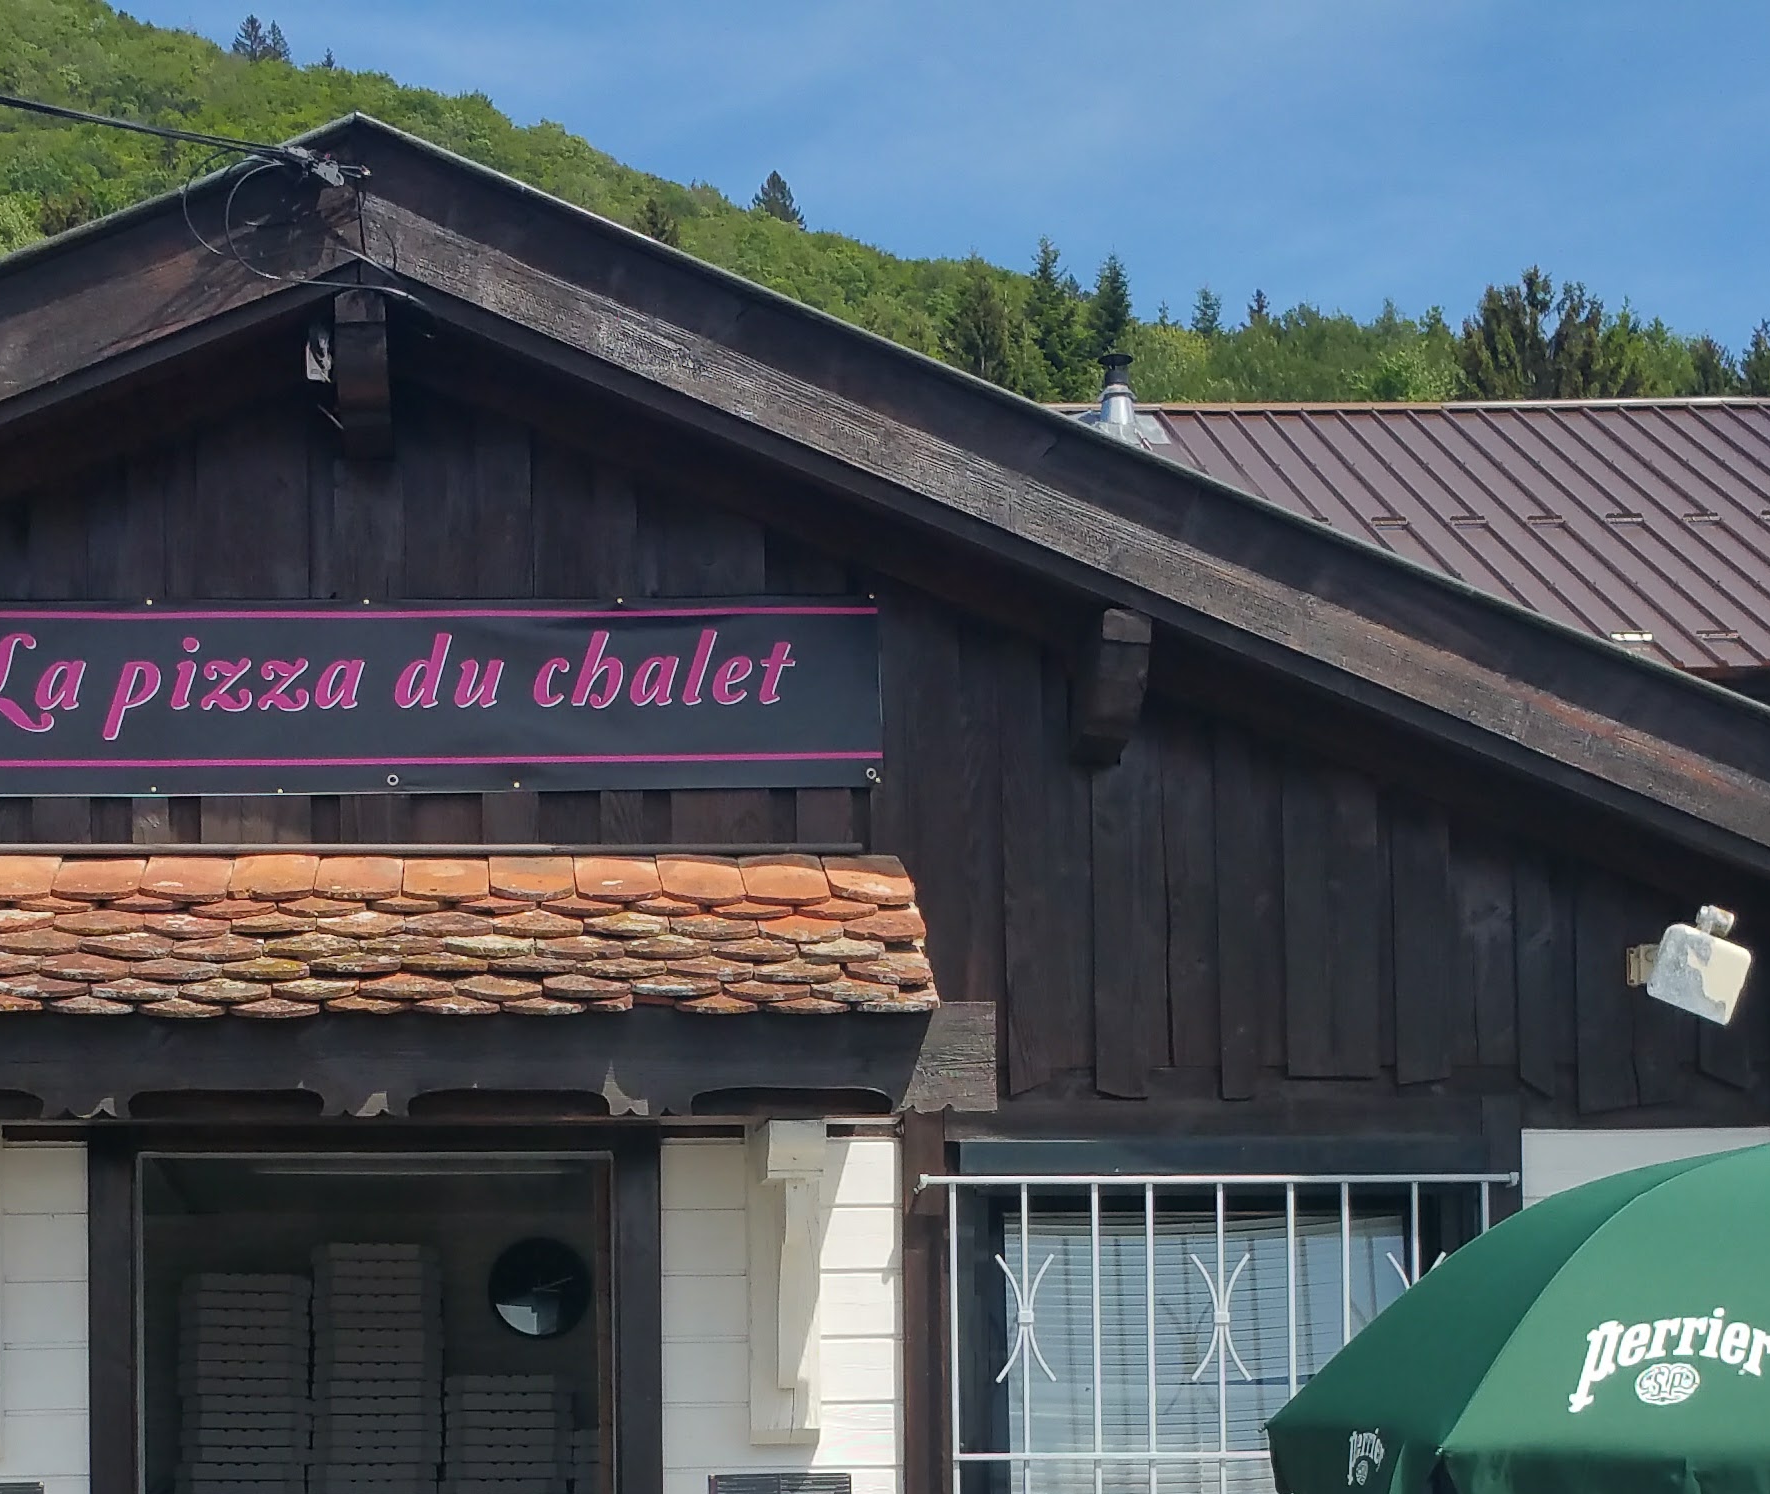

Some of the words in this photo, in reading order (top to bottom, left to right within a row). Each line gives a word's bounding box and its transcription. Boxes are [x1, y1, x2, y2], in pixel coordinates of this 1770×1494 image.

[101, 636, 365, 742] pizza
[393, 631, 503, 709] du
[531, 629, 797, 710] chalet
